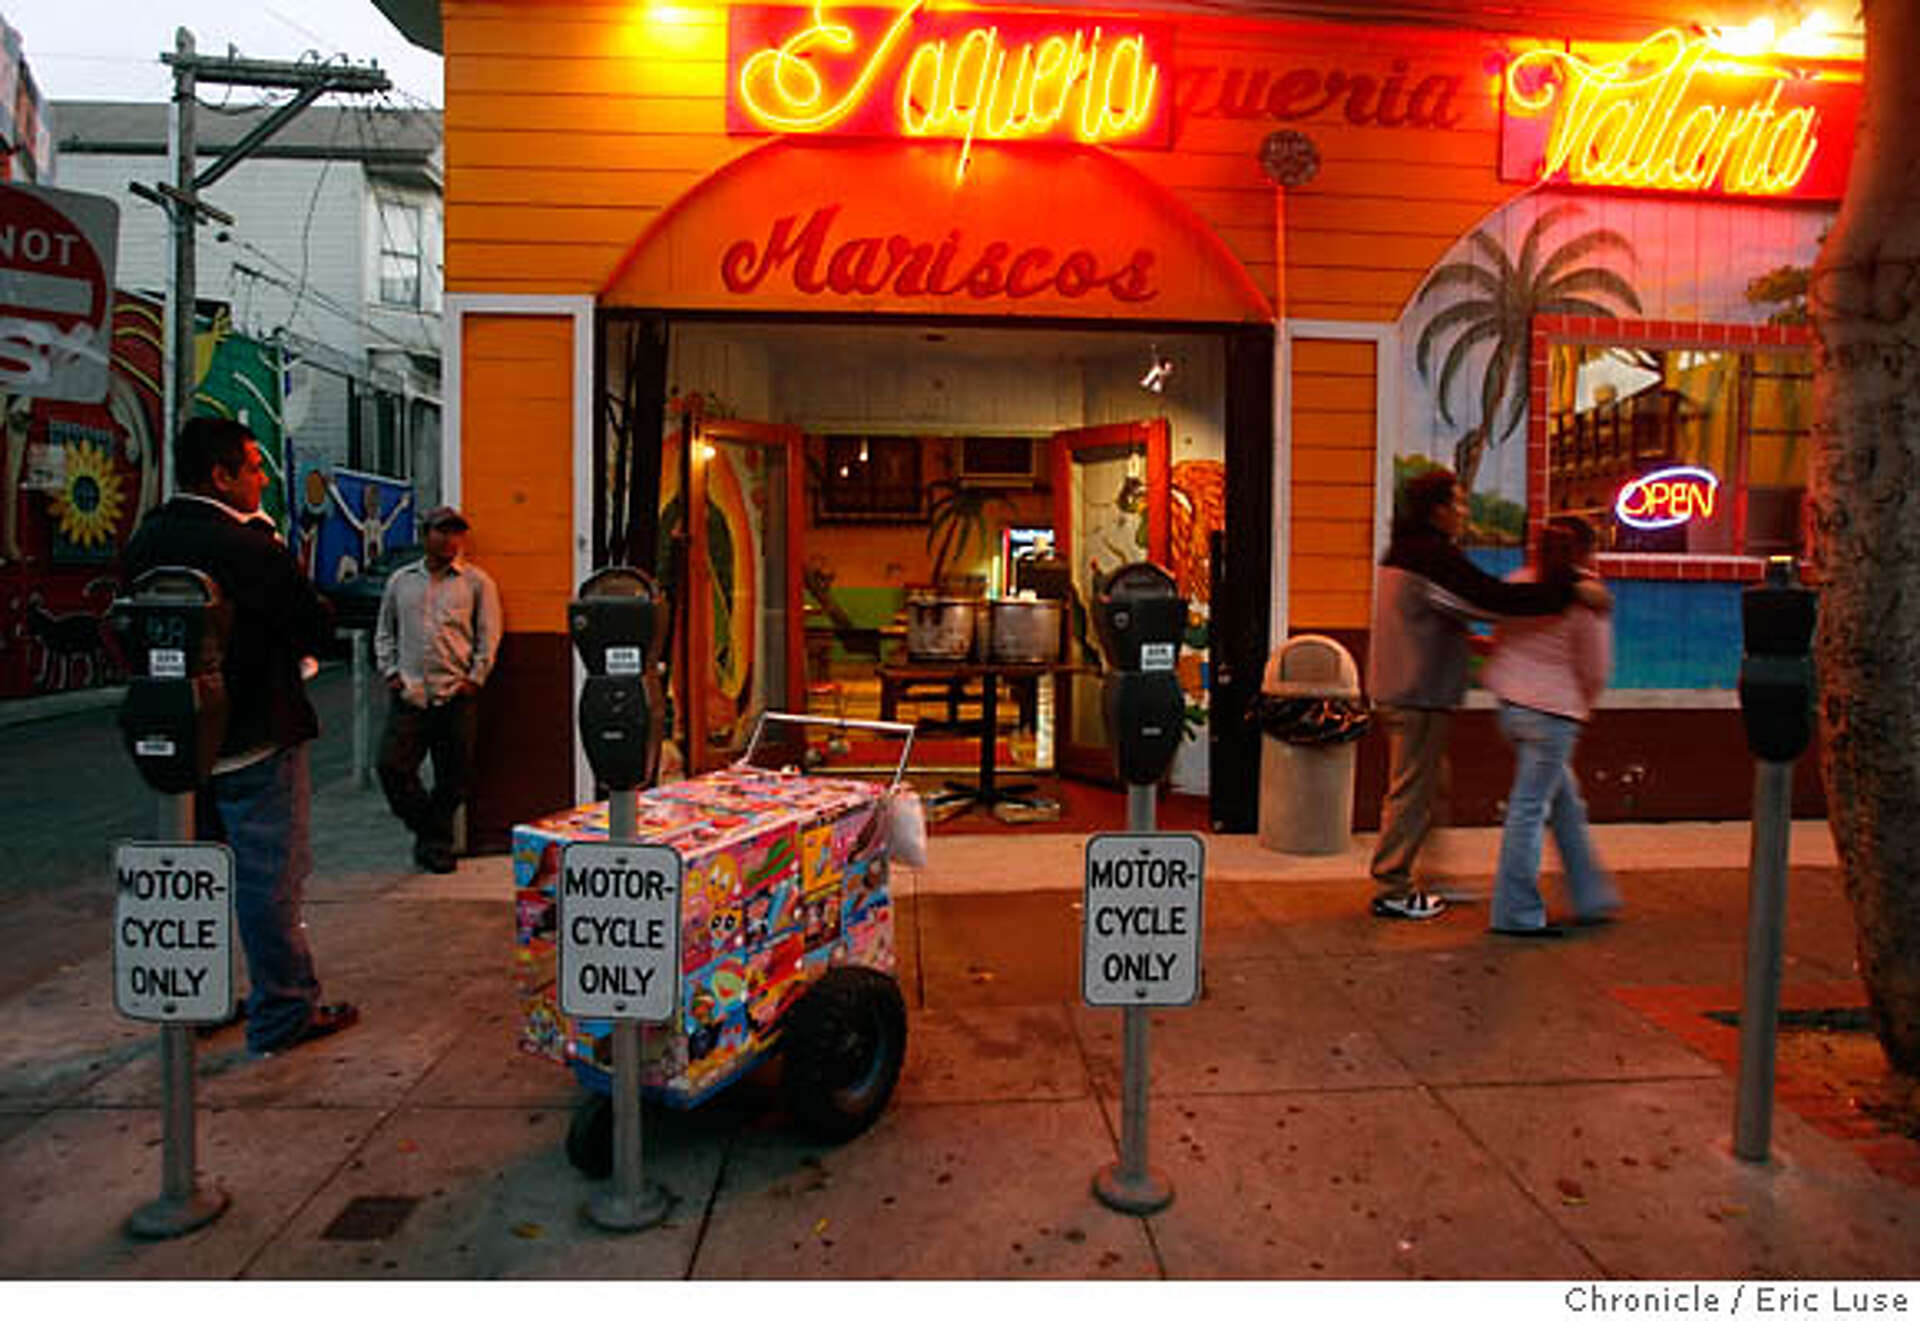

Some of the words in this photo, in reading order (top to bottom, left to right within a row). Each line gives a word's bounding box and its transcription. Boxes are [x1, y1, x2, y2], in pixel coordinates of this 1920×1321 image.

[1506, 27, 1818, 188] Vallarta
[721, 203, 1158, 302] Mariscos
[1620, 481, 1717, 518] OPEN
[565, 867, 674, 900] MOTOR-
[1091, 859, 1197, 889] MOTOR-
[122, 916, 217, 949] CYCLE
[571, 915, 665, 949] CYCLE
[1096, 906, 1187, 936] CYCLE
[132, 966, 207, 997] ONLY
[580, 963, 655, 997] ONLY
[1103, 952, 1177, 983] ONLY
